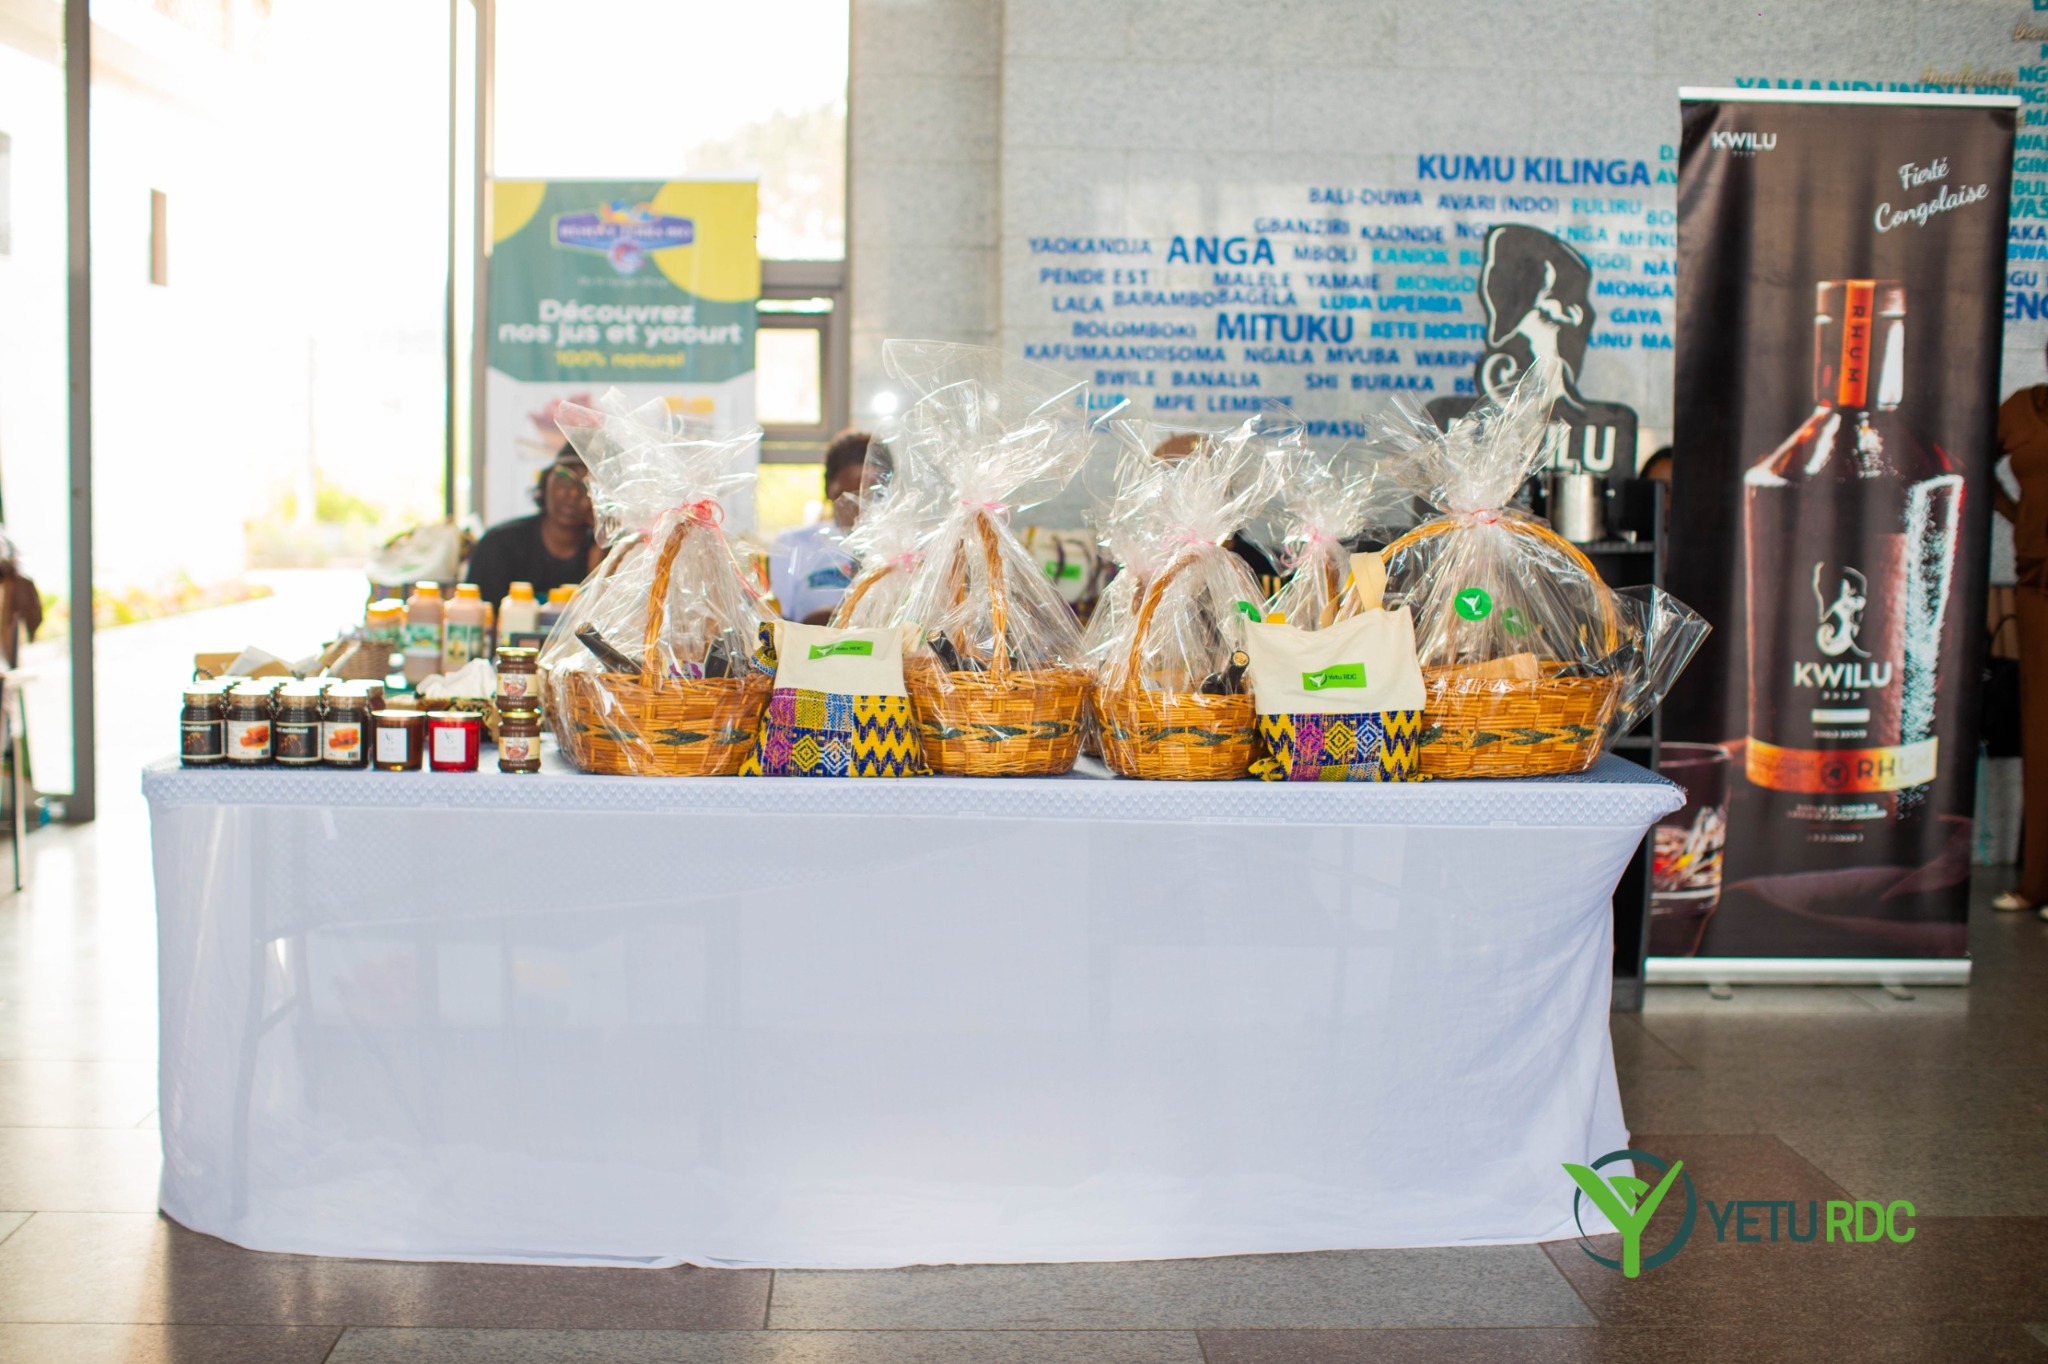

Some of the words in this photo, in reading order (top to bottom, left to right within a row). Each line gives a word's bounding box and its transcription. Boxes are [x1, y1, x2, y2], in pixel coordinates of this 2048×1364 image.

[1711, 131, 1777, 151] KWILU
[1418, 153, 1516, 183] KUMU
[1524, 157, 1651, 187] KILINGA
[1898, 157, 1951, 191] Fierté
[1571, 199, 1643, 215] FULIRU
[1873, 182, 1991, 234] Congolaise
[1360, 226, 1445, 243] KAONDE
[1166, 235, 1276, 266] ANGA
[1293, 247, 1358, 263] MBOLI
[1040, 268, 1105, 285] PENDE
[1213, 272, 1292, 288] MALELE
[1396, 275, 1478, 293] MONGO
[1596, 282, 1674, 298] MONGA
[1051, 297, 1104, 313] LALA
[1112, 291, 1217, 309] BARAMBO
[1319, 296, 1373, 310] LUBA
[1378, 296, 1464, 313] UPEMBA
[538, 299, 697, 325] Découvrez
[1610, 309, 1662, 324] GAYA
[498, 324, 552, 345] nos
[555, 323, 600, 348] jus
[605, 324, 639, 345] et
[643, 322, 743, 349] yaourt
[1215, 312, 1354, 345] MITUKU
[1847, 304, 1866, 384] RHUM
[555, 350, 606, 367] 100%
[610, 350, 686, 368] naturel
[1244, 348, 1314, 364] NGALA
[1325, 347, 1400, 364] MVUBA
[1094, 371, 1156, 386] BWILE
[1171, 372, 1262, 388] BANALIA
[1304, 374, 1339, 389] SHI
[1351, 375, 1435, 391] BURAKA
[1153, 395, 1197, 410] MPE
[1792, 661, 1893, 689] KWILU
